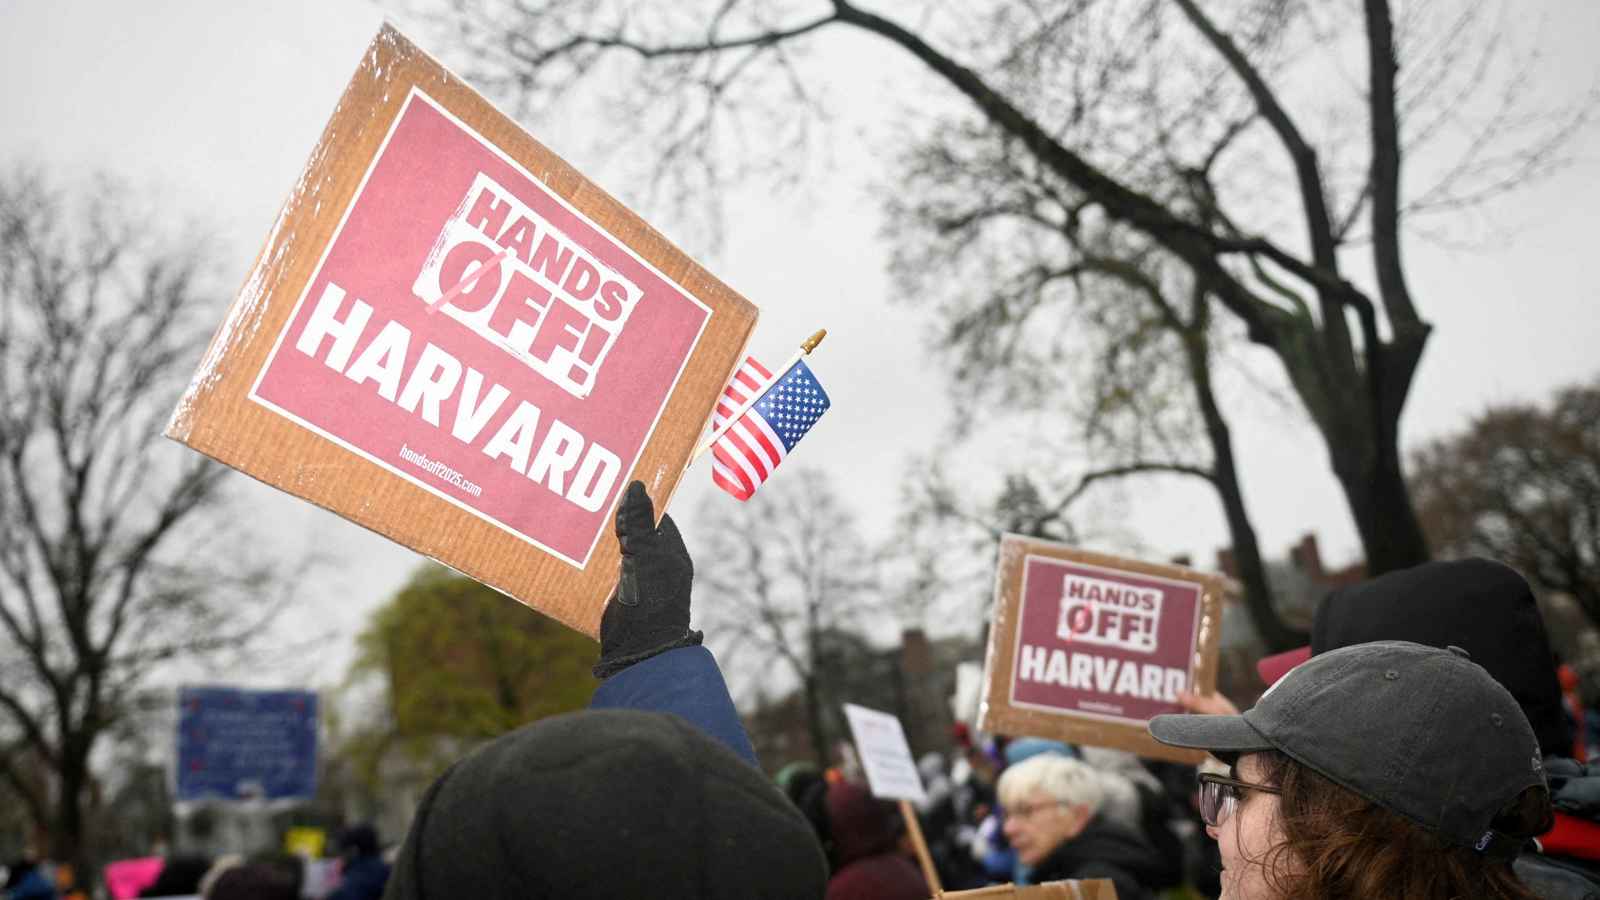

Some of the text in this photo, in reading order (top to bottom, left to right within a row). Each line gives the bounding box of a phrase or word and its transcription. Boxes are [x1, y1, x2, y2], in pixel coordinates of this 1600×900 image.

[464, 188, 629, 322] HANDS
[295, 281, 622, 513] HARVARD
[399, 443, 482, 497] handsoff2025.com
[1068, 580, 1155, 609] HANDS
[1019, 645, 1186, 703] HARVARD
